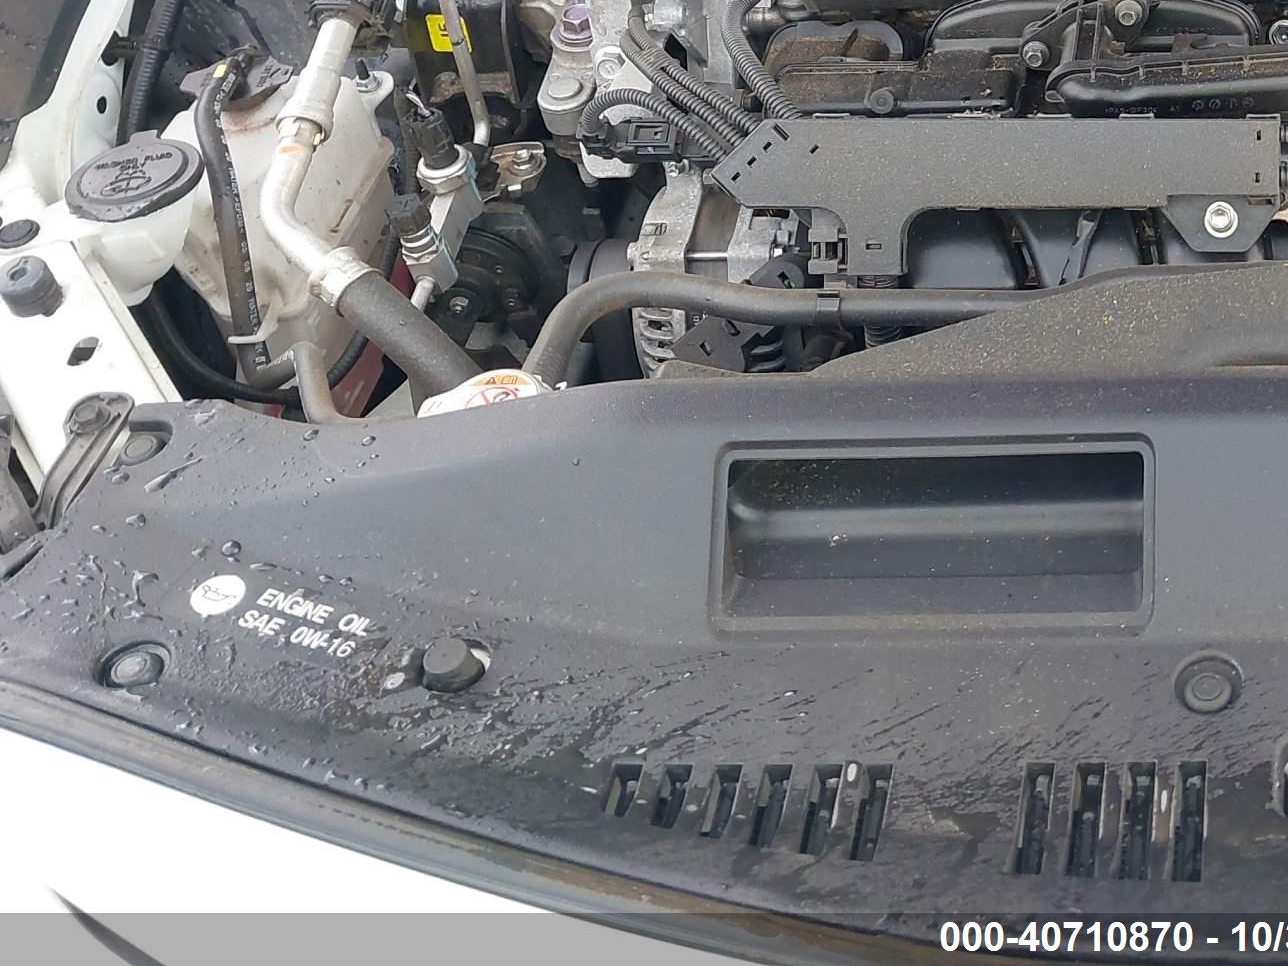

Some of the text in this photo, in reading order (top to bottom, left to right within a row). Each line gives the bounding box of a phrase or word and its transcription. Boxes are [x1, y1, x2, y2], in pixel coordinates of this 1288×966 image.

[238, 610, 357, 658] SAE 0W-16
[256, 588, 370, 637] ENGINE OIL
